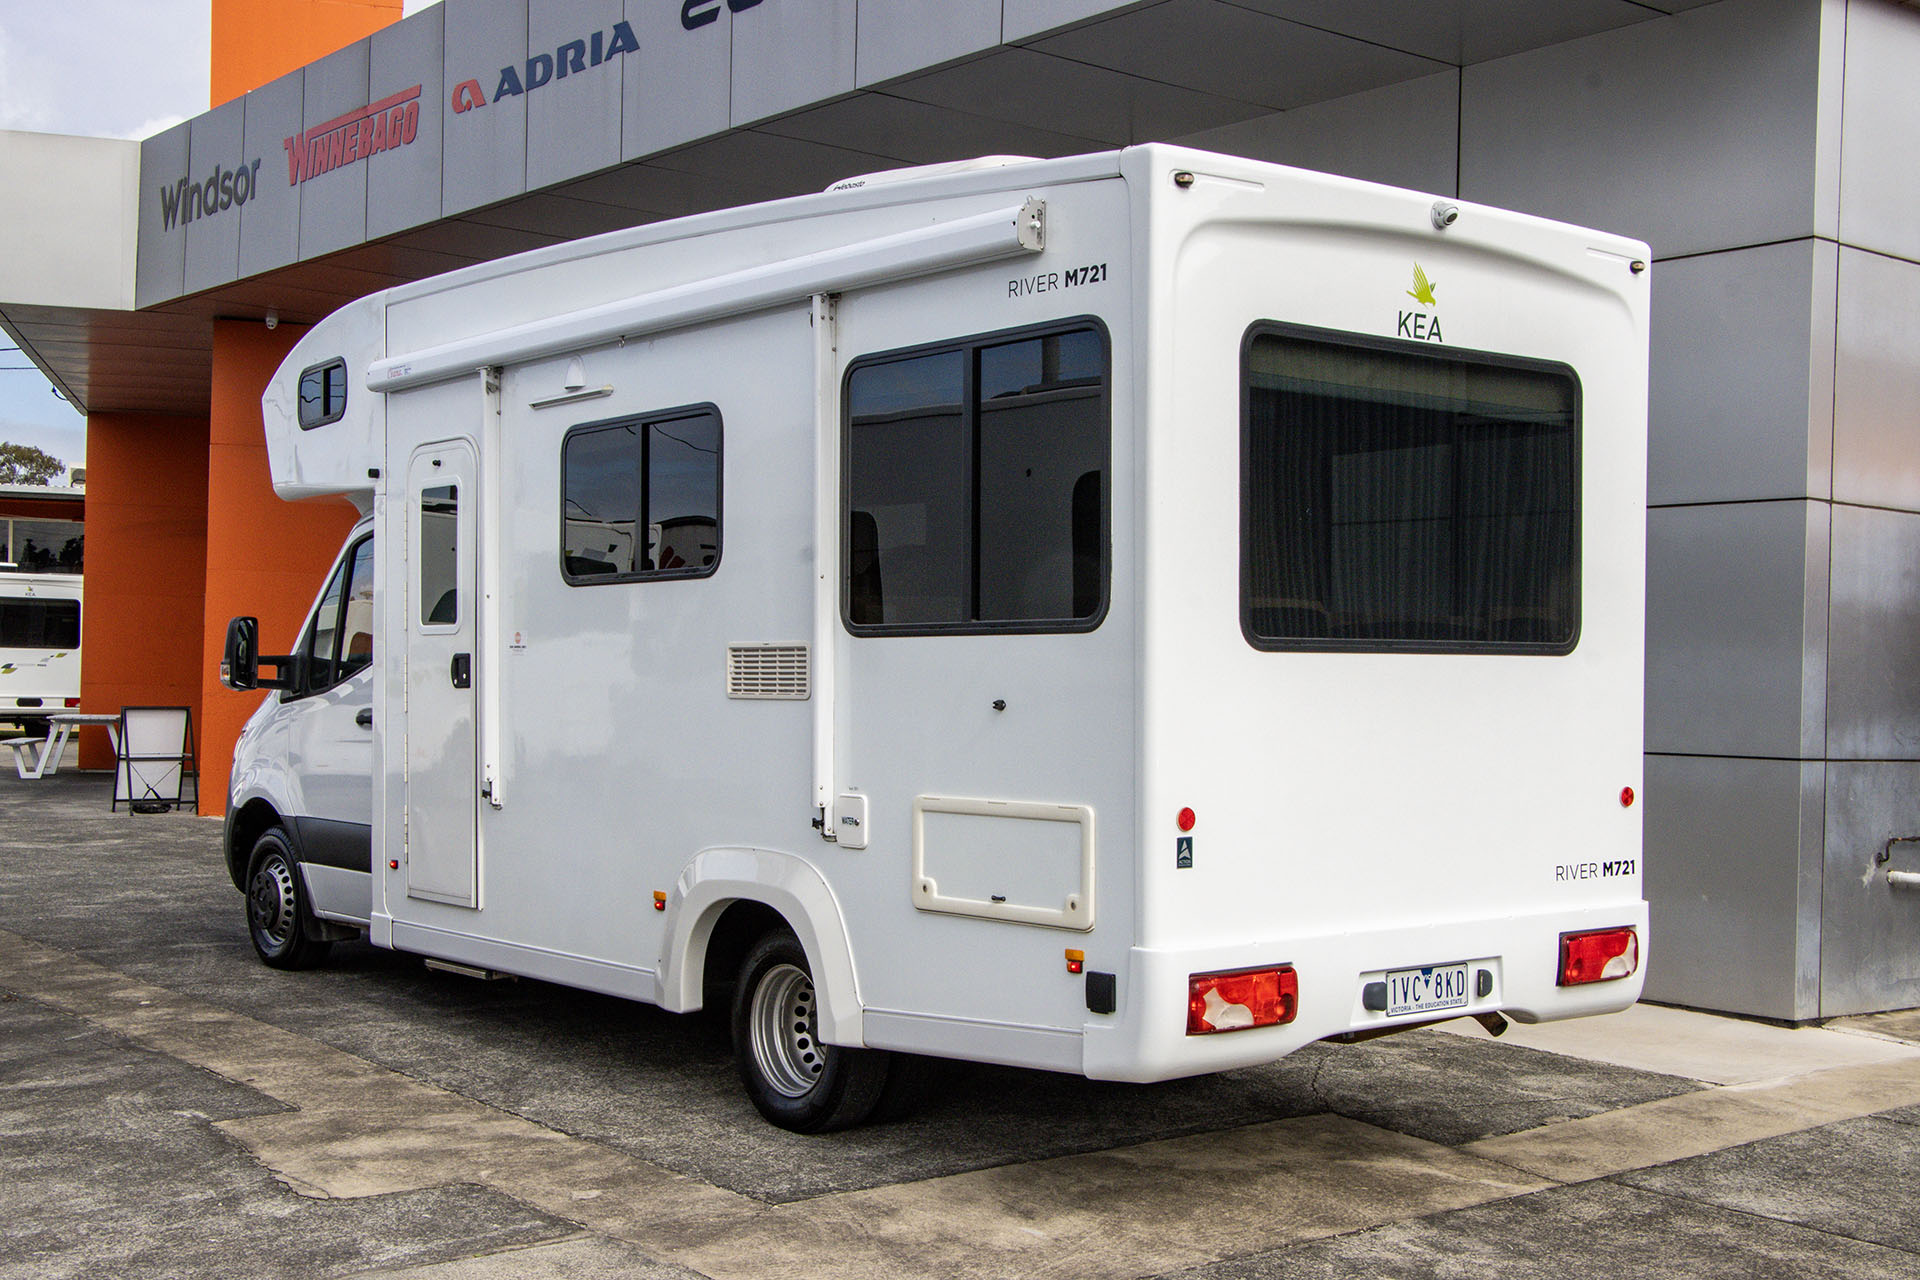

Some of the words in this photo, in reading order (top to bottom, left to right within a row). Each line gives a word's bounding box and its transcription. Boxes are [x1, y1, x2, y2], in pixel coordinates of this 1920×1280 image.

[493, 20, 641, 104] ADRIA
[283, 83, 422, 187] WINNEBAGO
[160, 157, 262, 232] Windsor
[1008, 272, 1059, 299] RIVER
[1064, 262, 1108, 288] M721
[1397, 310, 1443, 343] KEA
[1555, 862, 1598, 881] RIVER
[1602, 859, 1636, 877] M721
[1392, 975, 1421, 1005] 1VC
[1434, 970, 1465, 999] 8KD
[1390, 1005, 1412, 1014] VICTORIA
[1424, 1000, 1449, 1009] EDUCATION
